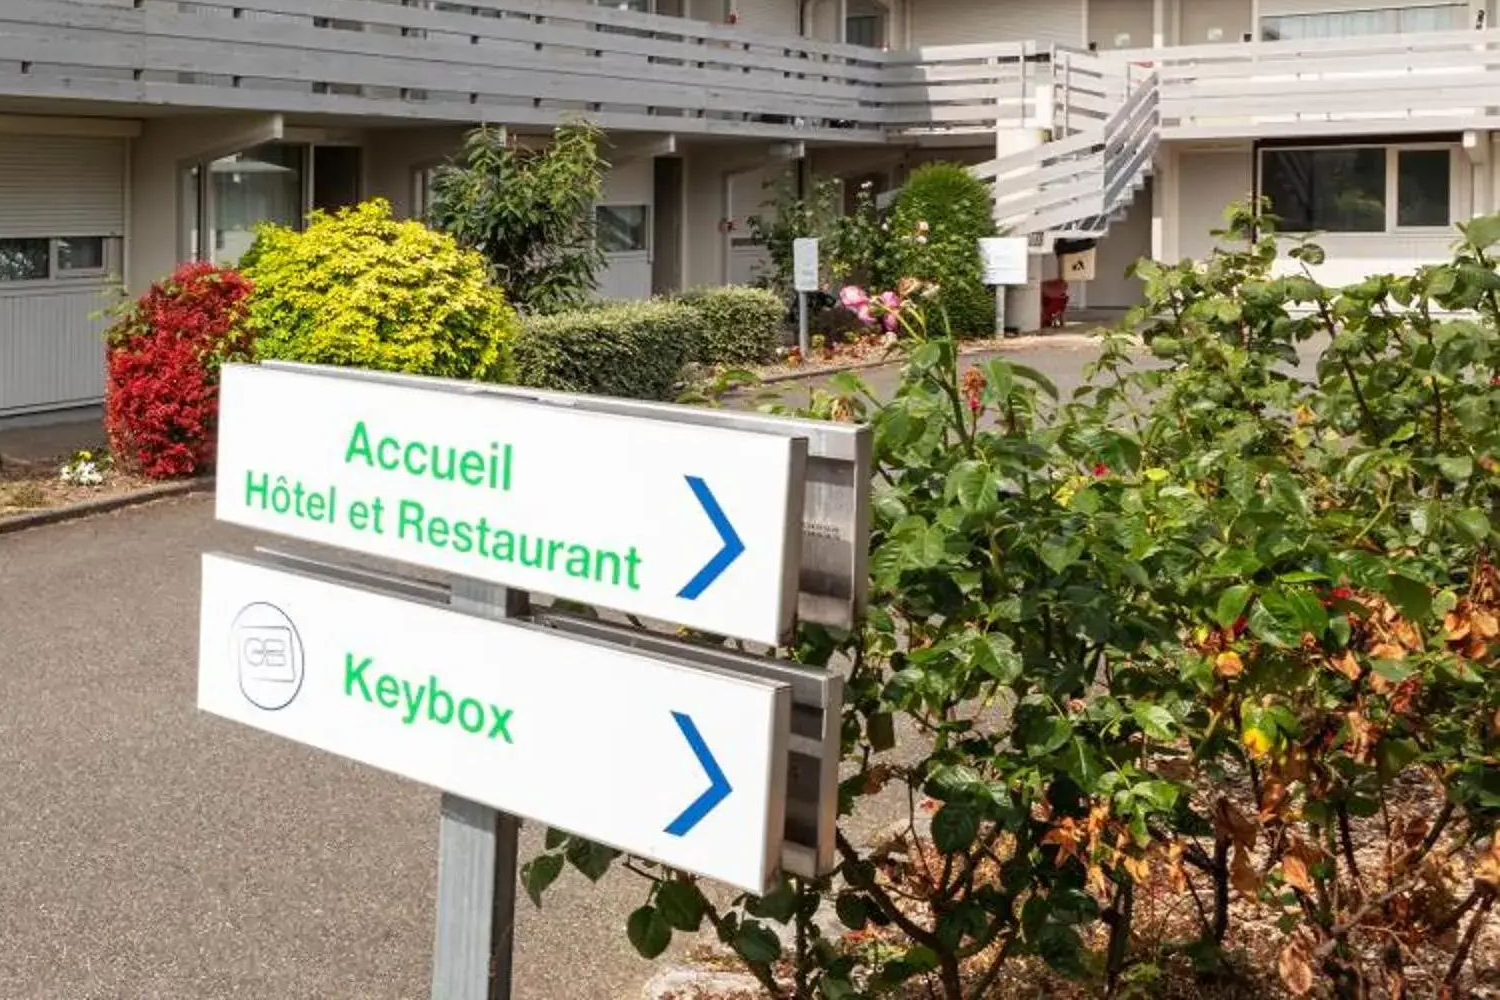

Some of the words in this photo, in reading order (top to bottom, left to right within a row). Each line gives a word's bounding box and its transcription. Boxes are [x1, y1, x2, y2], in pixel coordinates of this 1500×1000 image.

[343, 420, 514, 491] Accueil
[244, 471, 337, 523] Hôtel
[347, 496, 384, 535] et
[396, 498, 643, 592] Restaurant
[343, 651, 514, 744] Keybox
